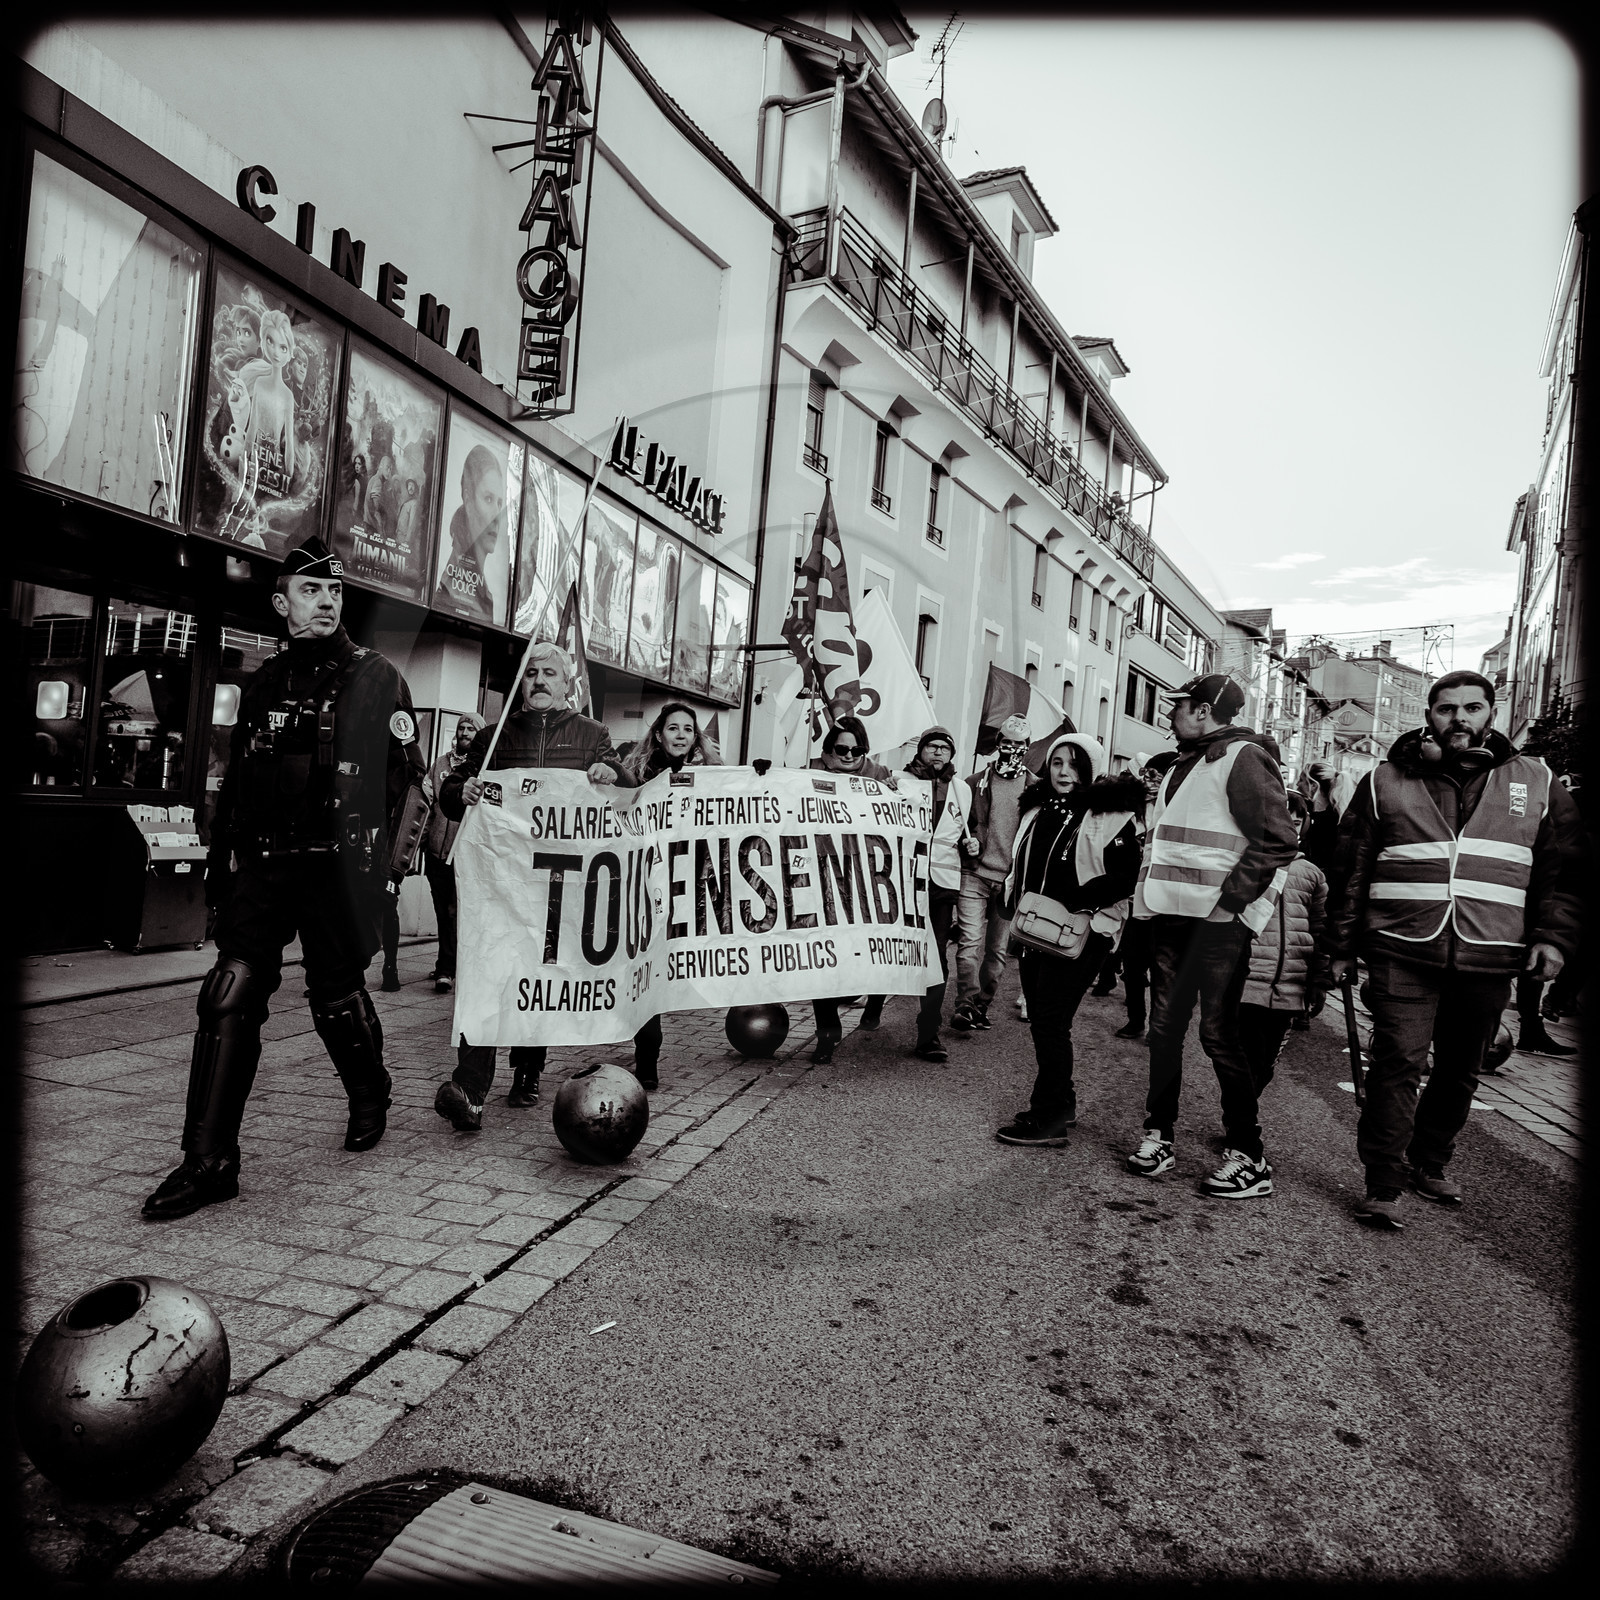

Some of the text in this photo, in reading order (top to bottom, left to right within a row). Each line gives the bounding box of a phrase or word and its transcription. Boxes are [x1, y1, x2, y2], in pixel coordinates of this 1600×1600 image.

[516, 28, 584, 384] ALACE
[236, 164, 483, 374] CINEMA
[610, 416, 729, 535] LE PALACE
[369, 534, 384, 544] BLACK
[446, 563, 484, 587] CHANSON
[451, 577, 477, 597] DOUCE
[865, 780, 878, 793] FO
[1510, 787, 1526, 795] cgt
[531, 800, 622, 839] SALARIÉS
[694, 790, 781, 827] RETRAITÉS
[797, 797, 853, 825] JEUNES
[871, 798, 916, 829] PRIVÉS
[532, 833, 928, 966] TOUS ENSEMBLE
[517, 977, 617, 1013] SALAIRES
[667, 946, 750, 981] SERVICES
[761, 938, 838, 974] PUBLICS
[868, 936, 922, 968] PROTECTION
